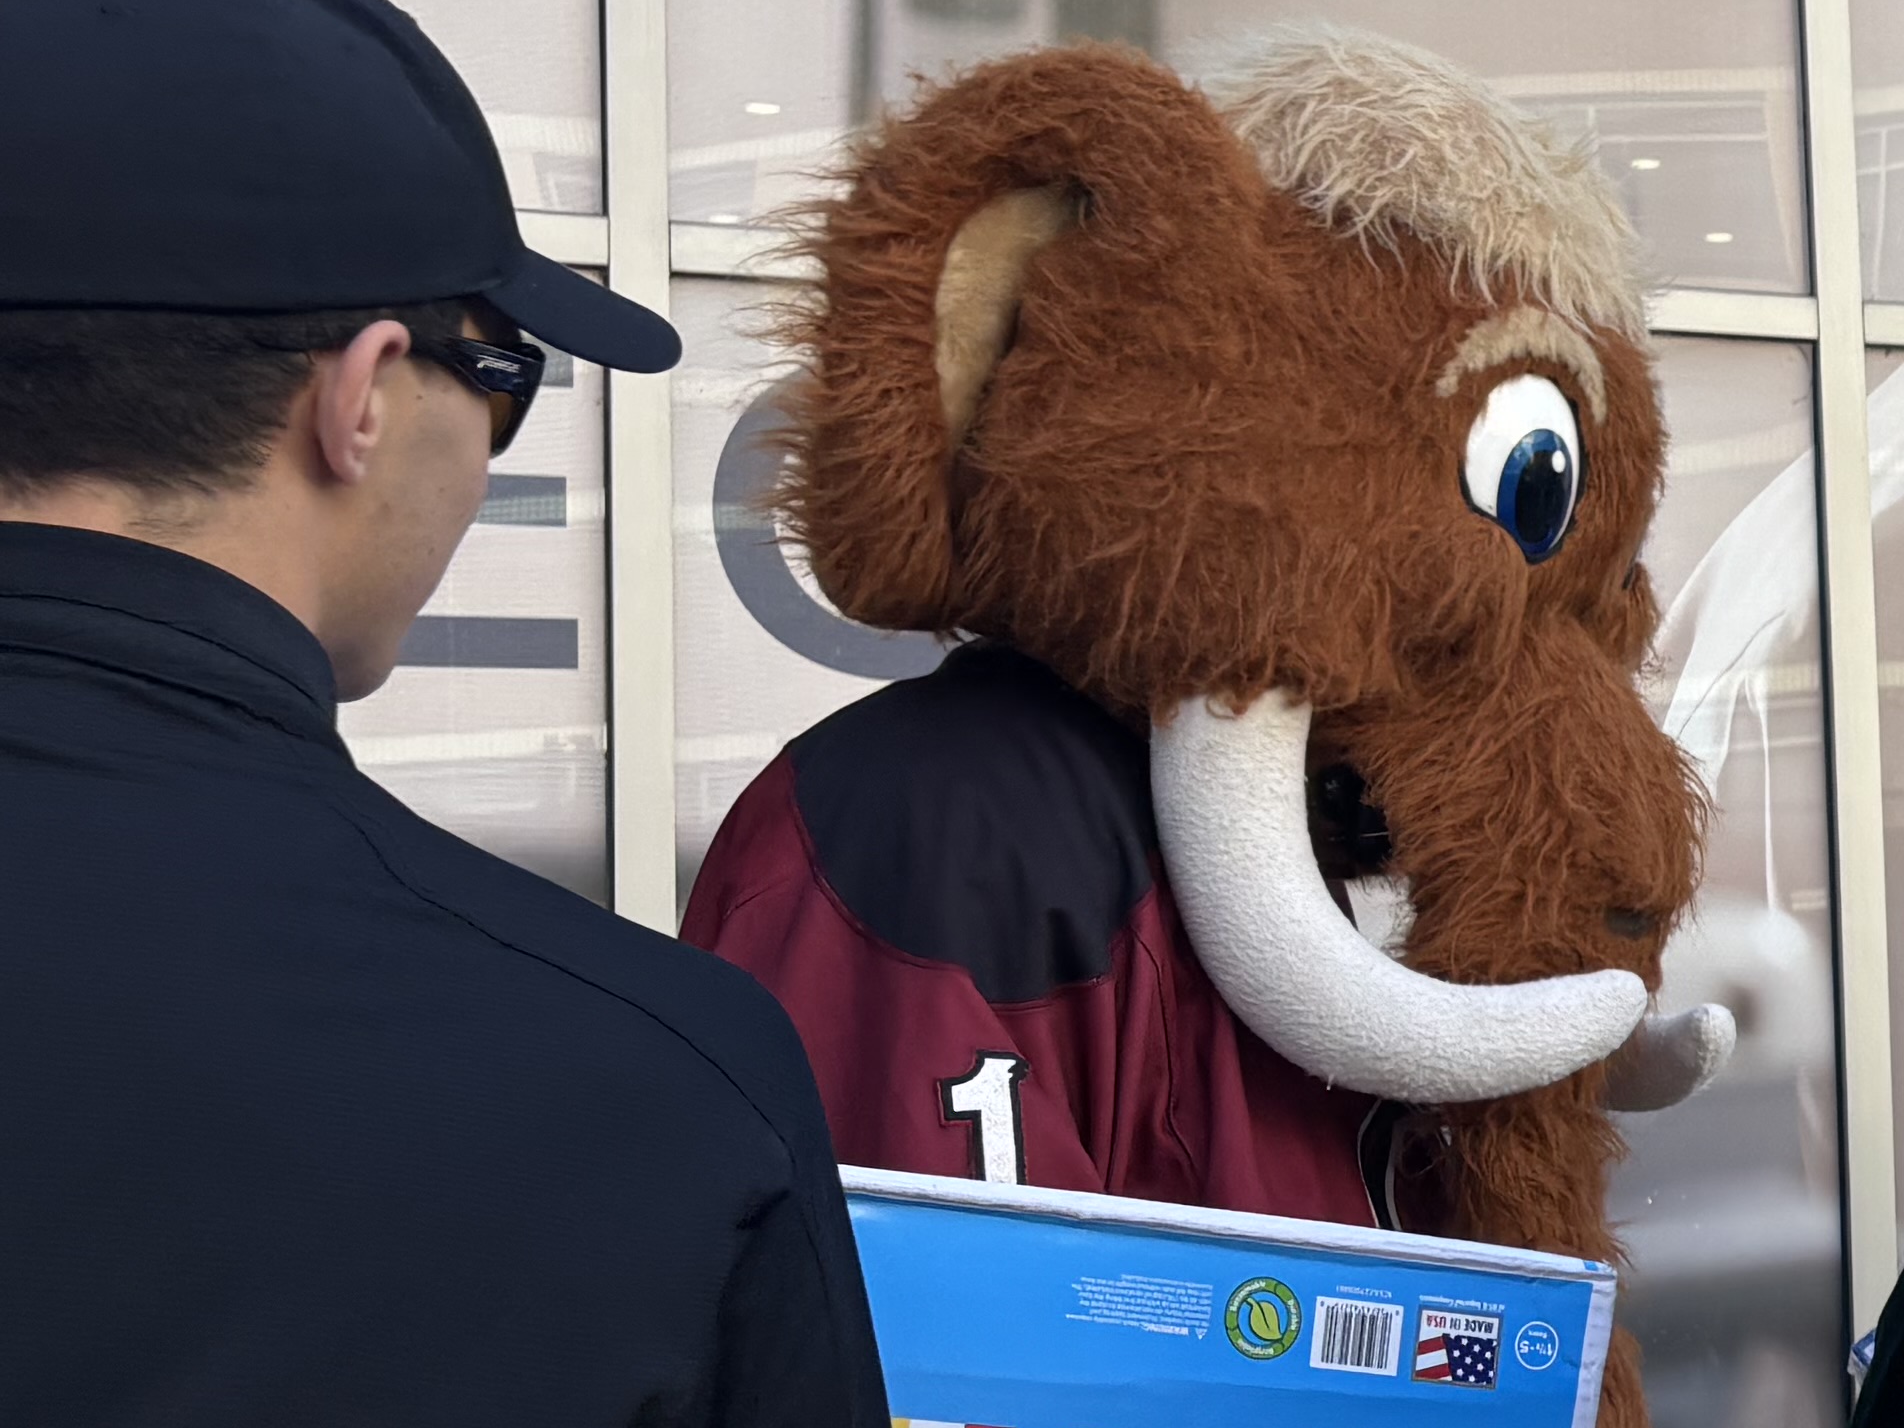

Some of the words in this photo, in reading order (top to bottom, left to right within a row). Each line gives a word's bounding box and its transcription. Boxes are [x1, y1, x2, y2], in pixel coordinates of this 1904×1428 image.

[1426, 1314, 1447, 1328] USA
[1450, 1316, 1461, 1330] IN
[1464, 1318, 1495, 1334] MADE
